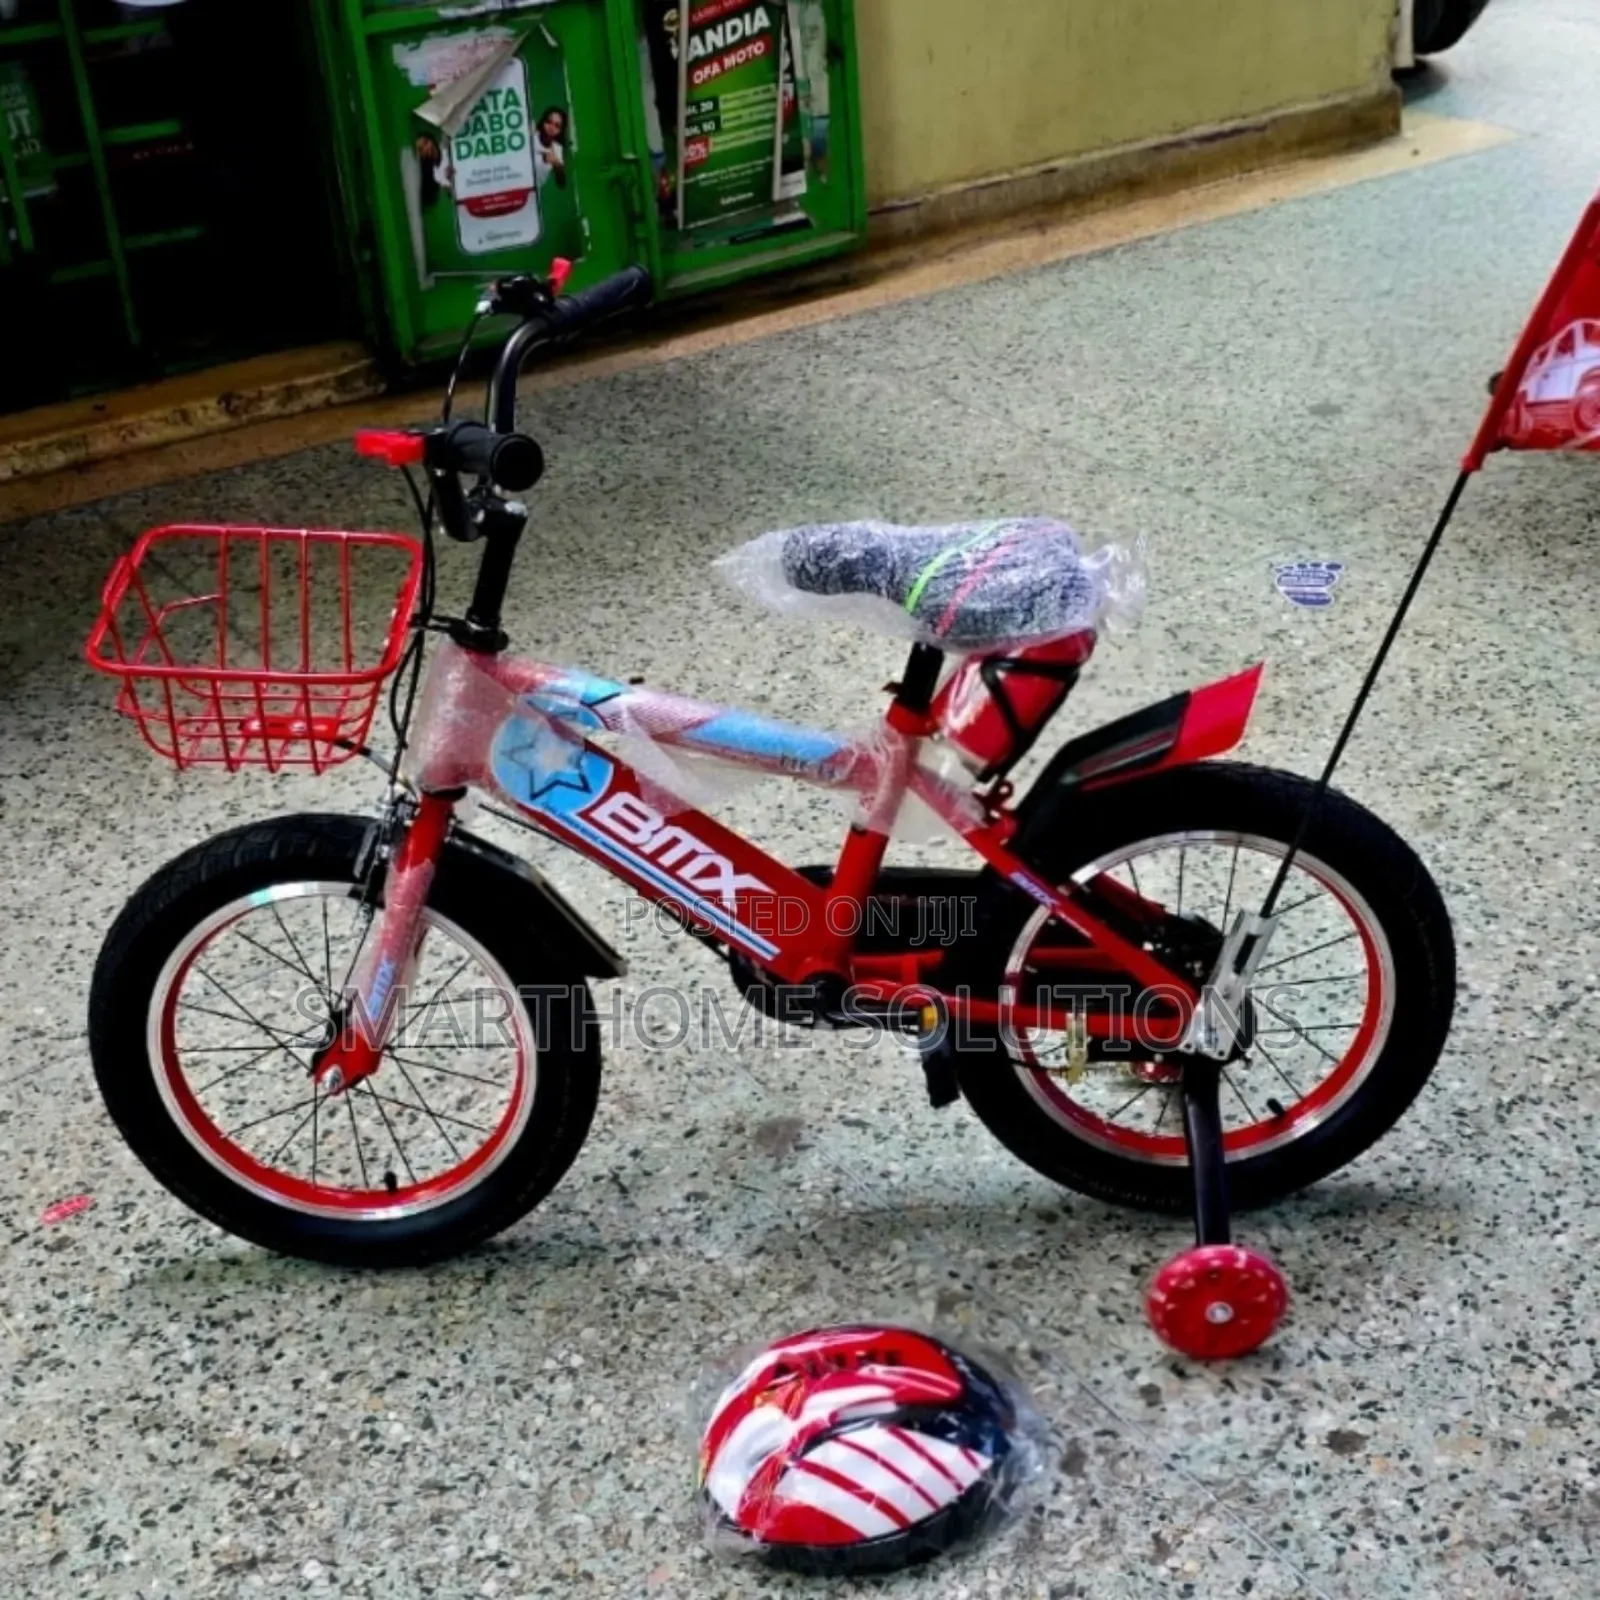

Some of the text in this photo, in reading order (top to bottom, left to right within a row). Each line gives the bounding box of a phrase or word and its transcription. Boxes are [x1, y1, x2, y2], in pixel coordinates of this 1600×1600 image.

[687, 5, 771, 63] ANDIA
[693, 40, 765, 85] OFA MOTO
[468, 87, 522, 116] ATA
[455, 132, 526, 161] DABO
[590, 791, 778, 915] BMX
